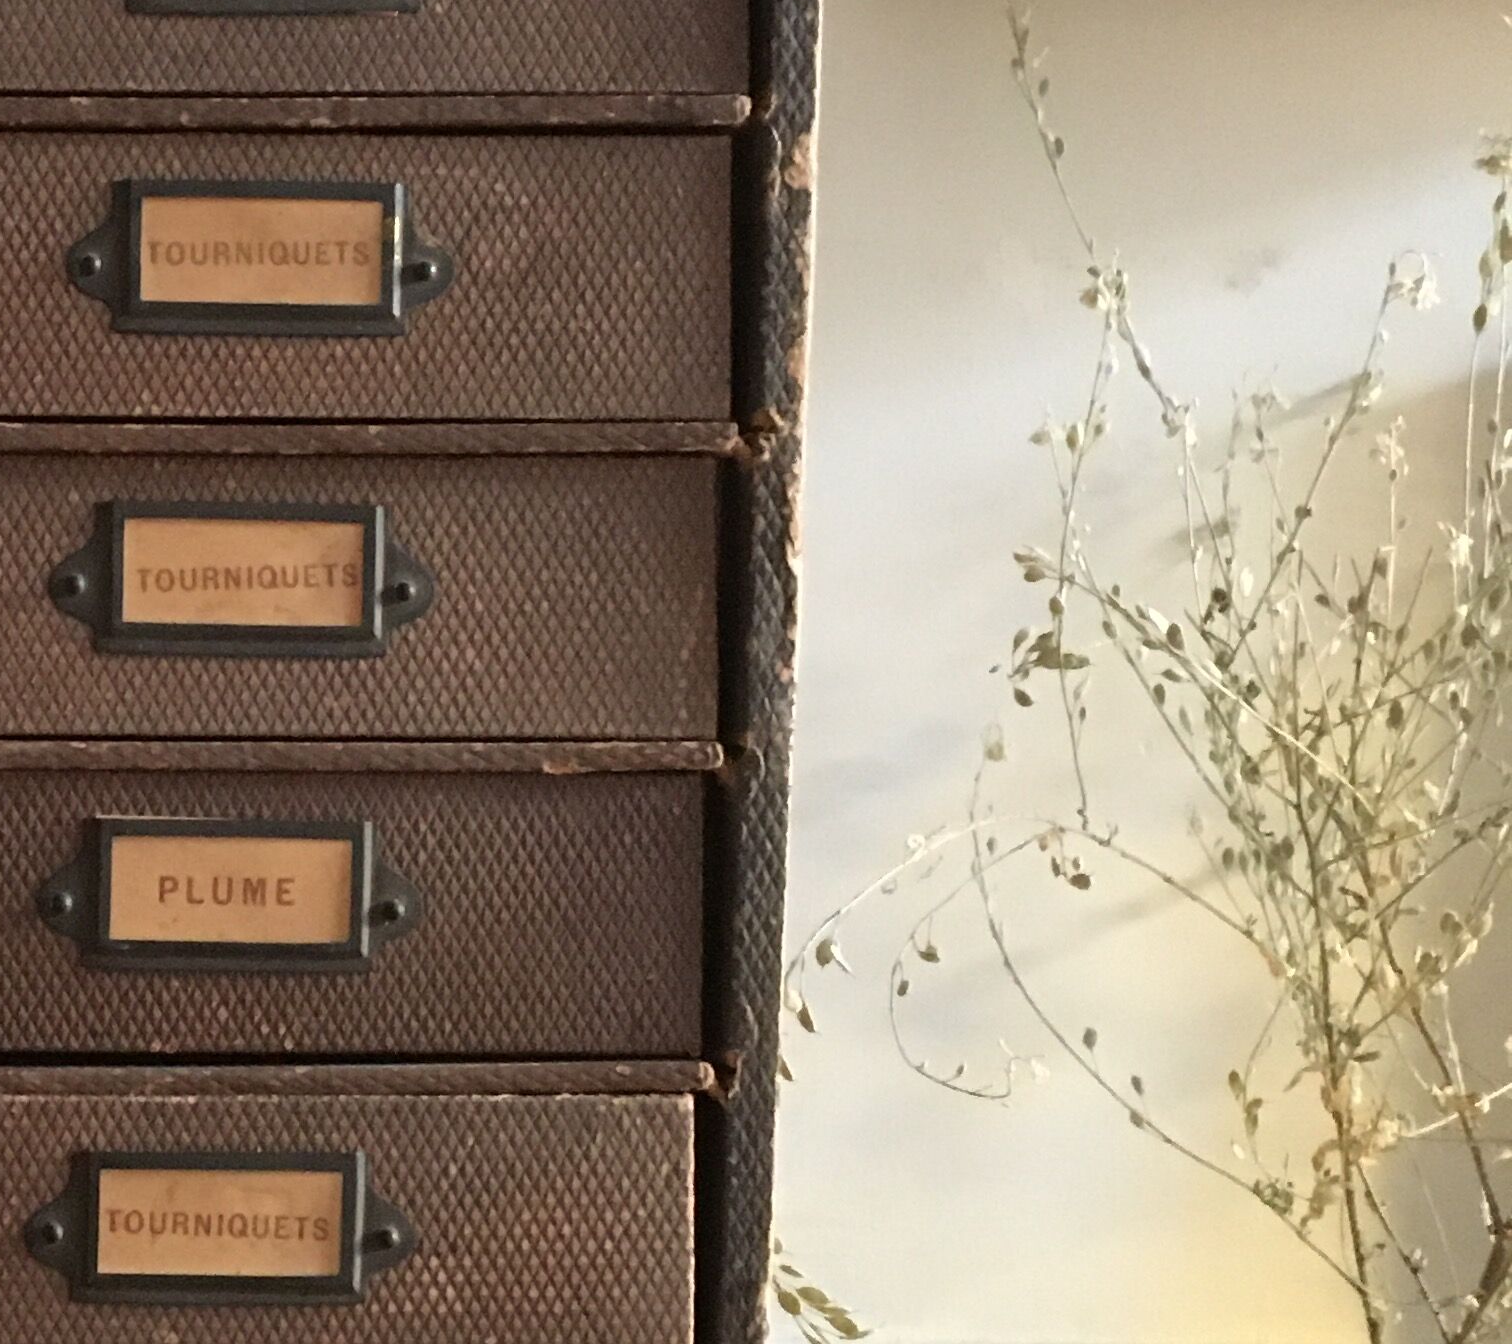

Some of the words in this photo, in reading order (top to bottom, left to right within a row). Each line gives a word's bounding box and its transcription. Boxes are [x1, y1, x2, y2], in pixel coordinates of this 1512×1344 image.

[148, 239, 369, 266] TOURNIQUETS
[138, 562, 358, 593] TOURNIQUETS
[158, 876, 296, 907] PLUME
[107, 1209, 329, 1240] TOURNIQUETS
